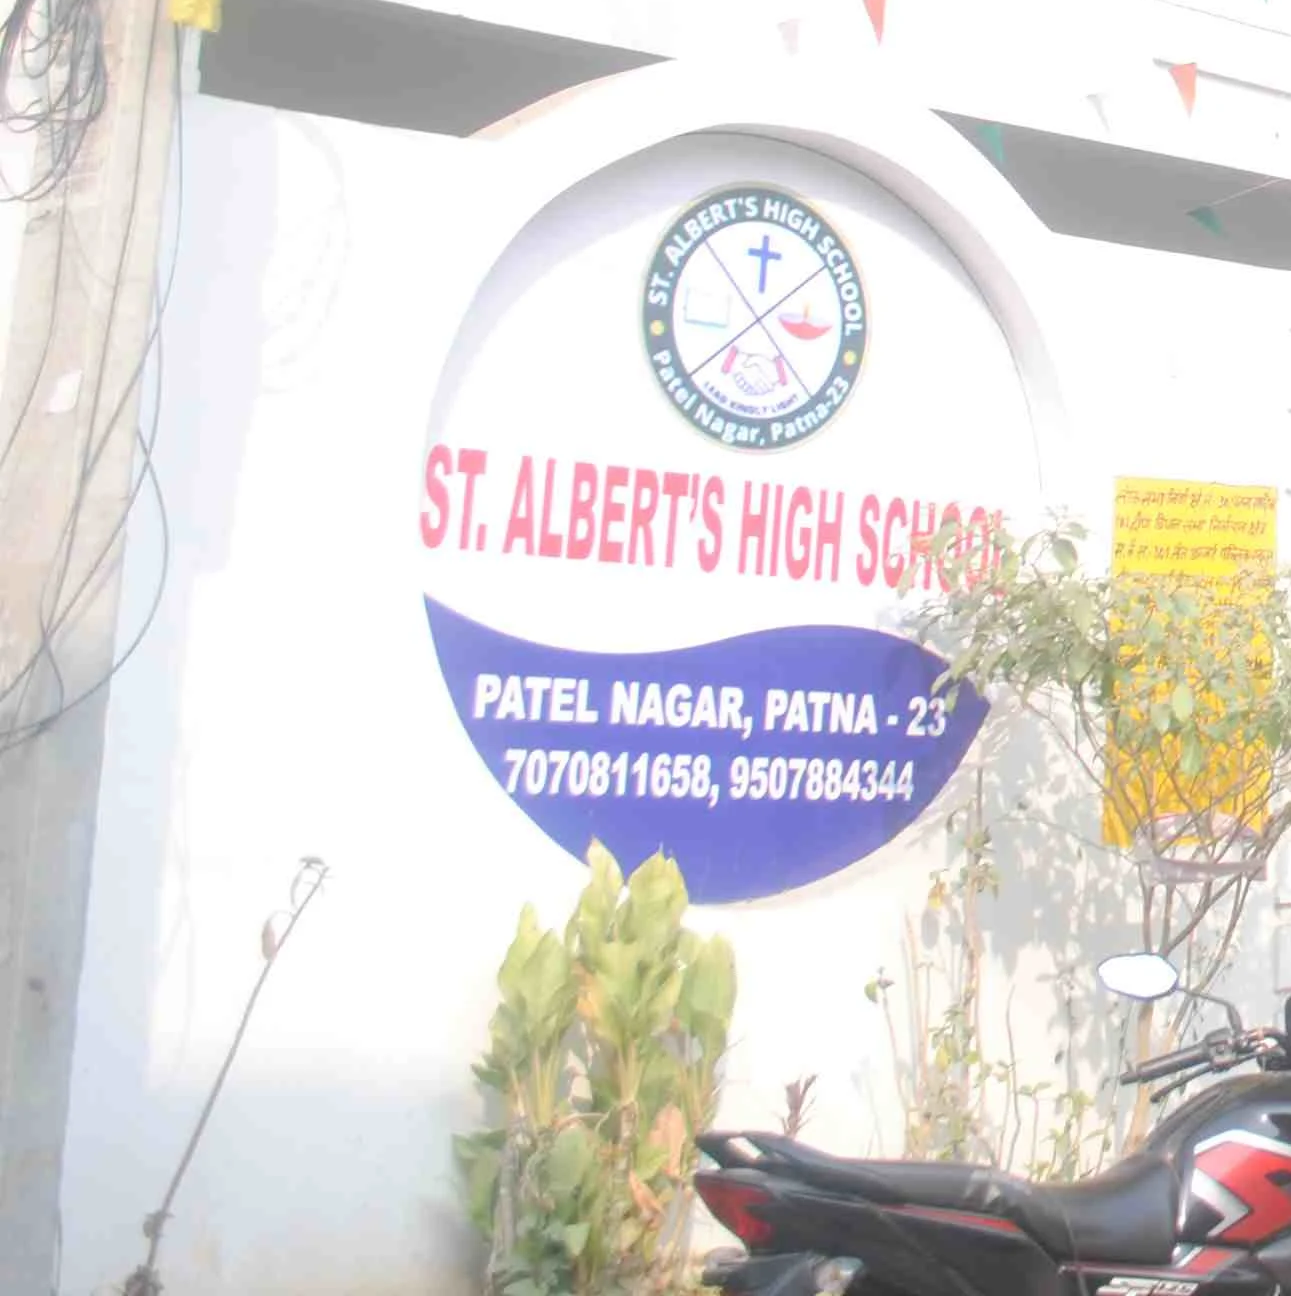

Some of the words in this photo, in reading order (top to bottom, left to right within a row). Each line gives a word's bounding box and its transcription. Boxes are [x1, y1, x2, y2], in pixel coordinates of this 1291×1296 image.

[648, 272, 674, 307] ST.
[665, 196, 759, 266] ALBERT'S
[763, 199, 821, 241] HIGH
[816, 236, 863, 336] SCHOOL
[653, 349, 698, 410] Patel
[694, 401, 766, 447] Nagar,
[770, 376, 849, 441] Patna-23
[419, 443, 488, 551] ST.
[502, 454, 725, 573] ALBERT'S
[738, 479, 844, 583] HIGH
[473, 673, 599, 725] PATEL
[609, 680, 754, 740] NAGAR,
[763, 689, 878, 735] PATNA
[906, 695, 947, 738] 23
[503, 749, 720, 807] 7070811658,
[729, 754, 915, 802] 9507884344
